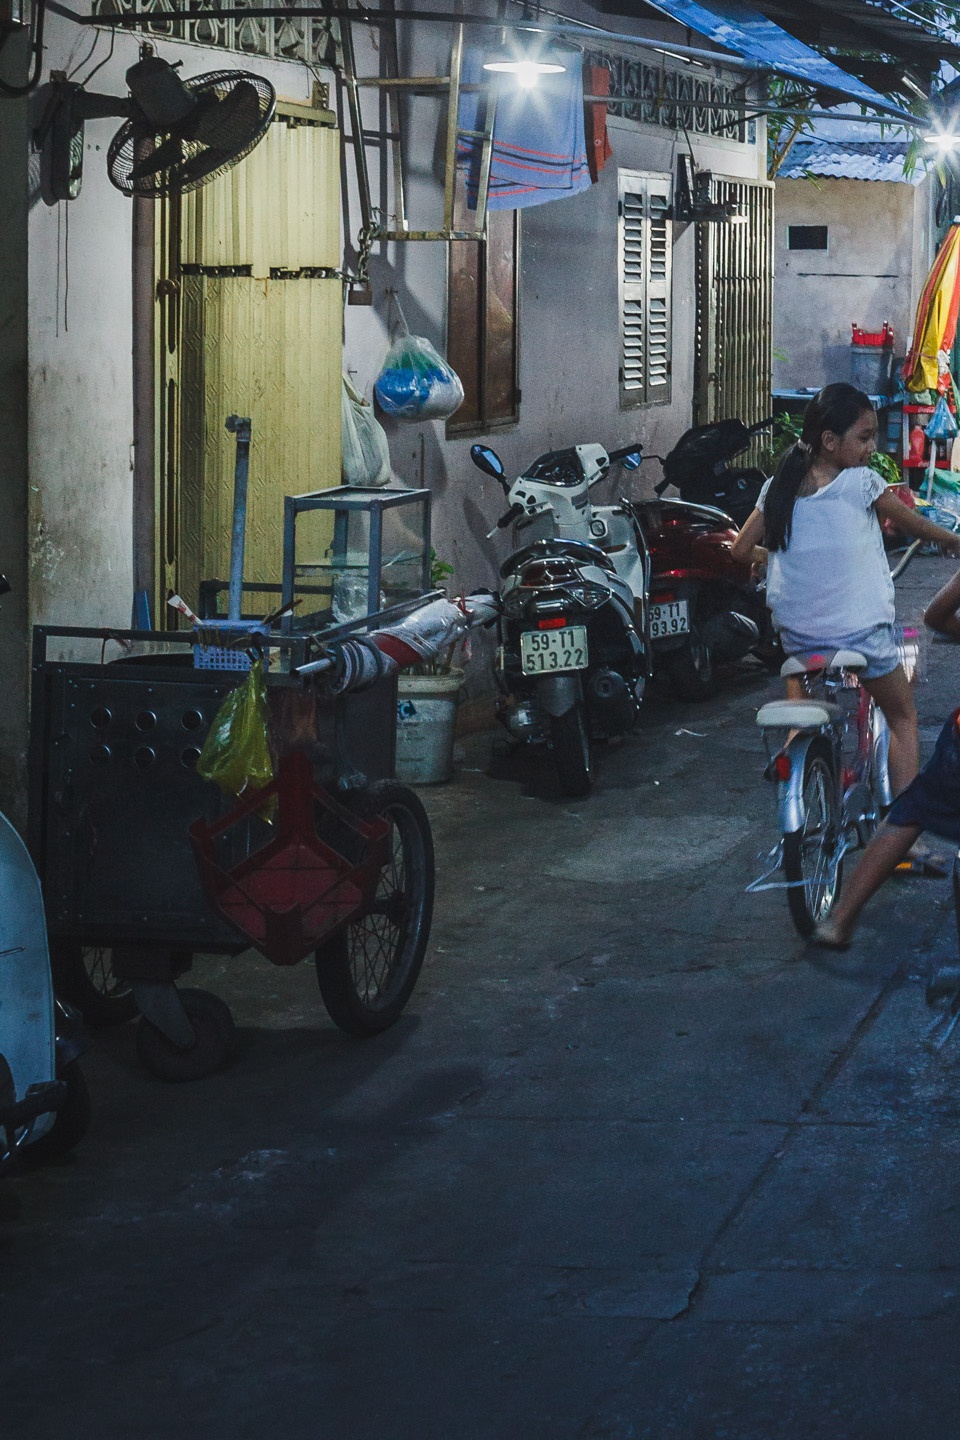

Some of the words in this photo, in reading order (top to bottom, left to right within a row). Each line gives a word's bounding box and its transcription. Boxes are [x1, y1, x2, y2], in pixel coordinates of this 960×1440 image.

[651, 617, 686, 636] 93.92
[531, 629, 575, 652] 59-T1
[526, 648, 584, 671] 513.22
